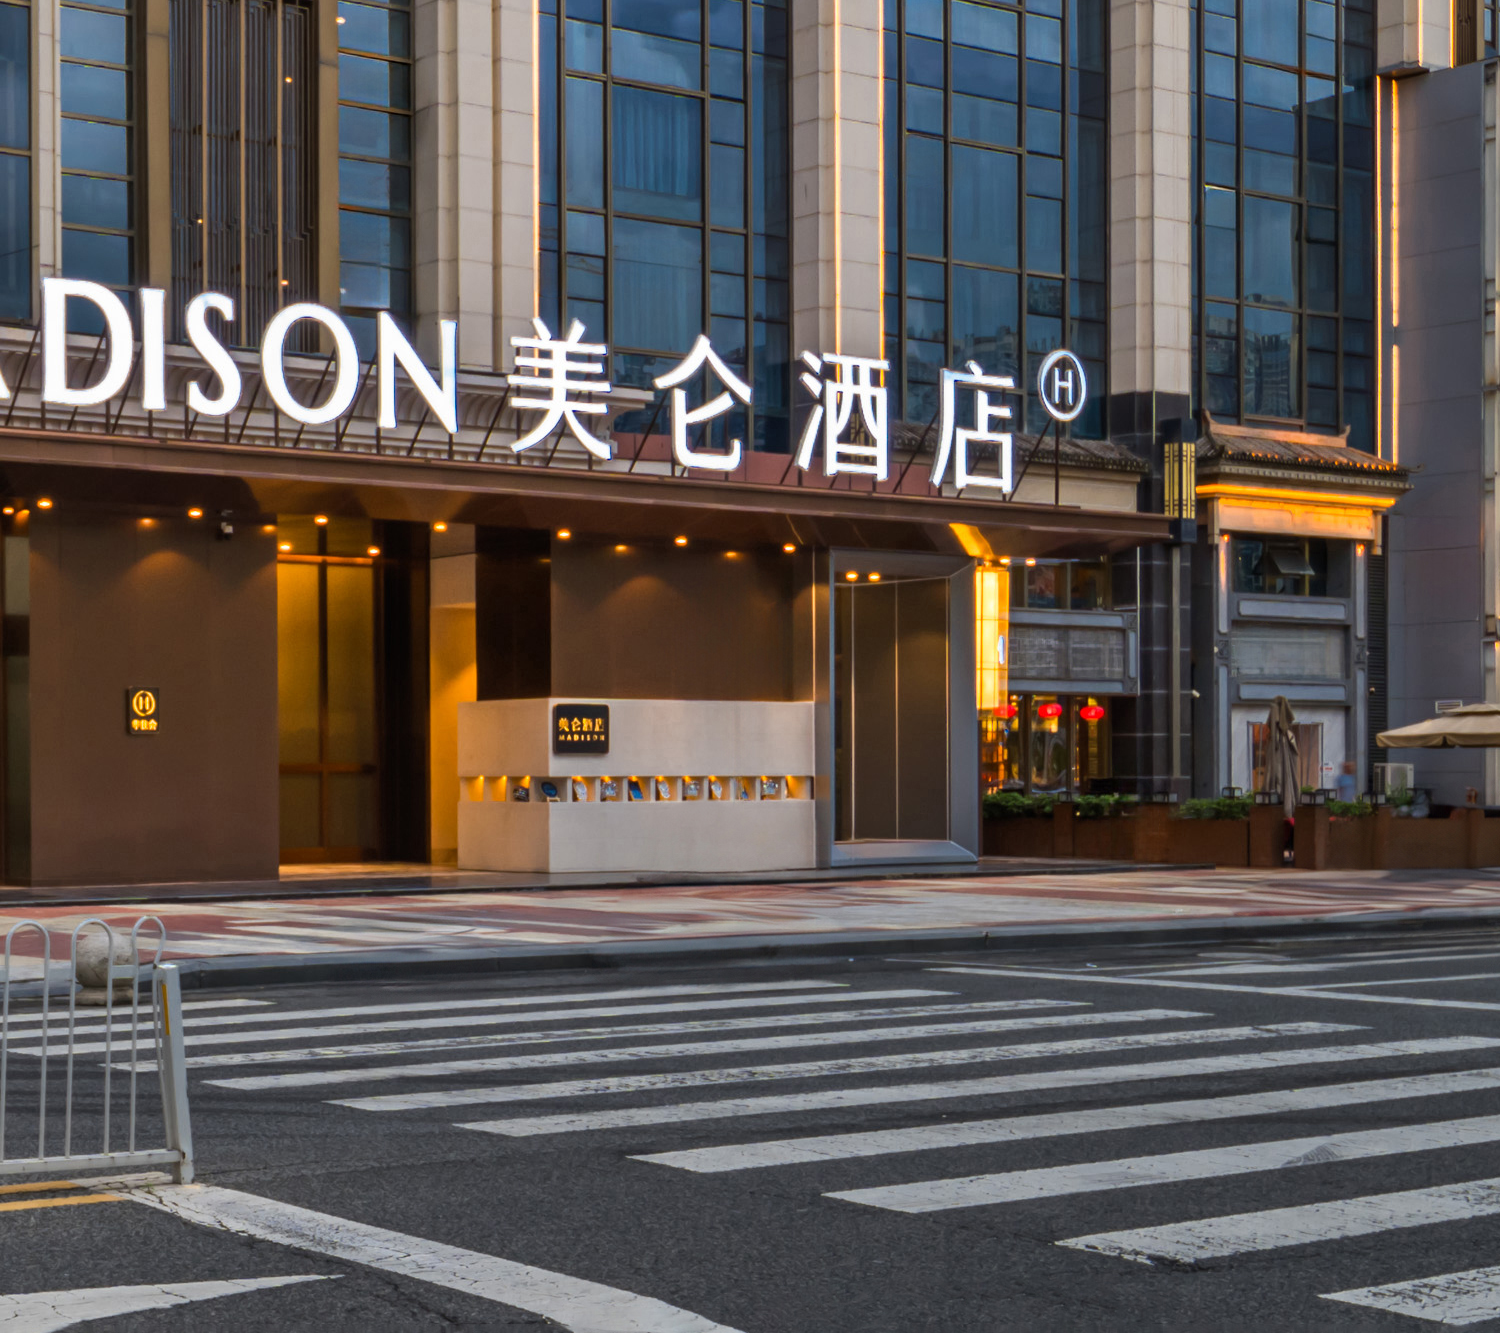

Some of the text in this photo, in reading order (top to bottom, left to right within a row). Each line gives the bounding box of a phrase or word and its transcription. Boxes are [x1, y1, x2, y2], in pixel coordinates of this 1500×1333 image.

[506, 317, 1018, 496] 美仑酒店
[558, 733, 605, 742] MADISON
